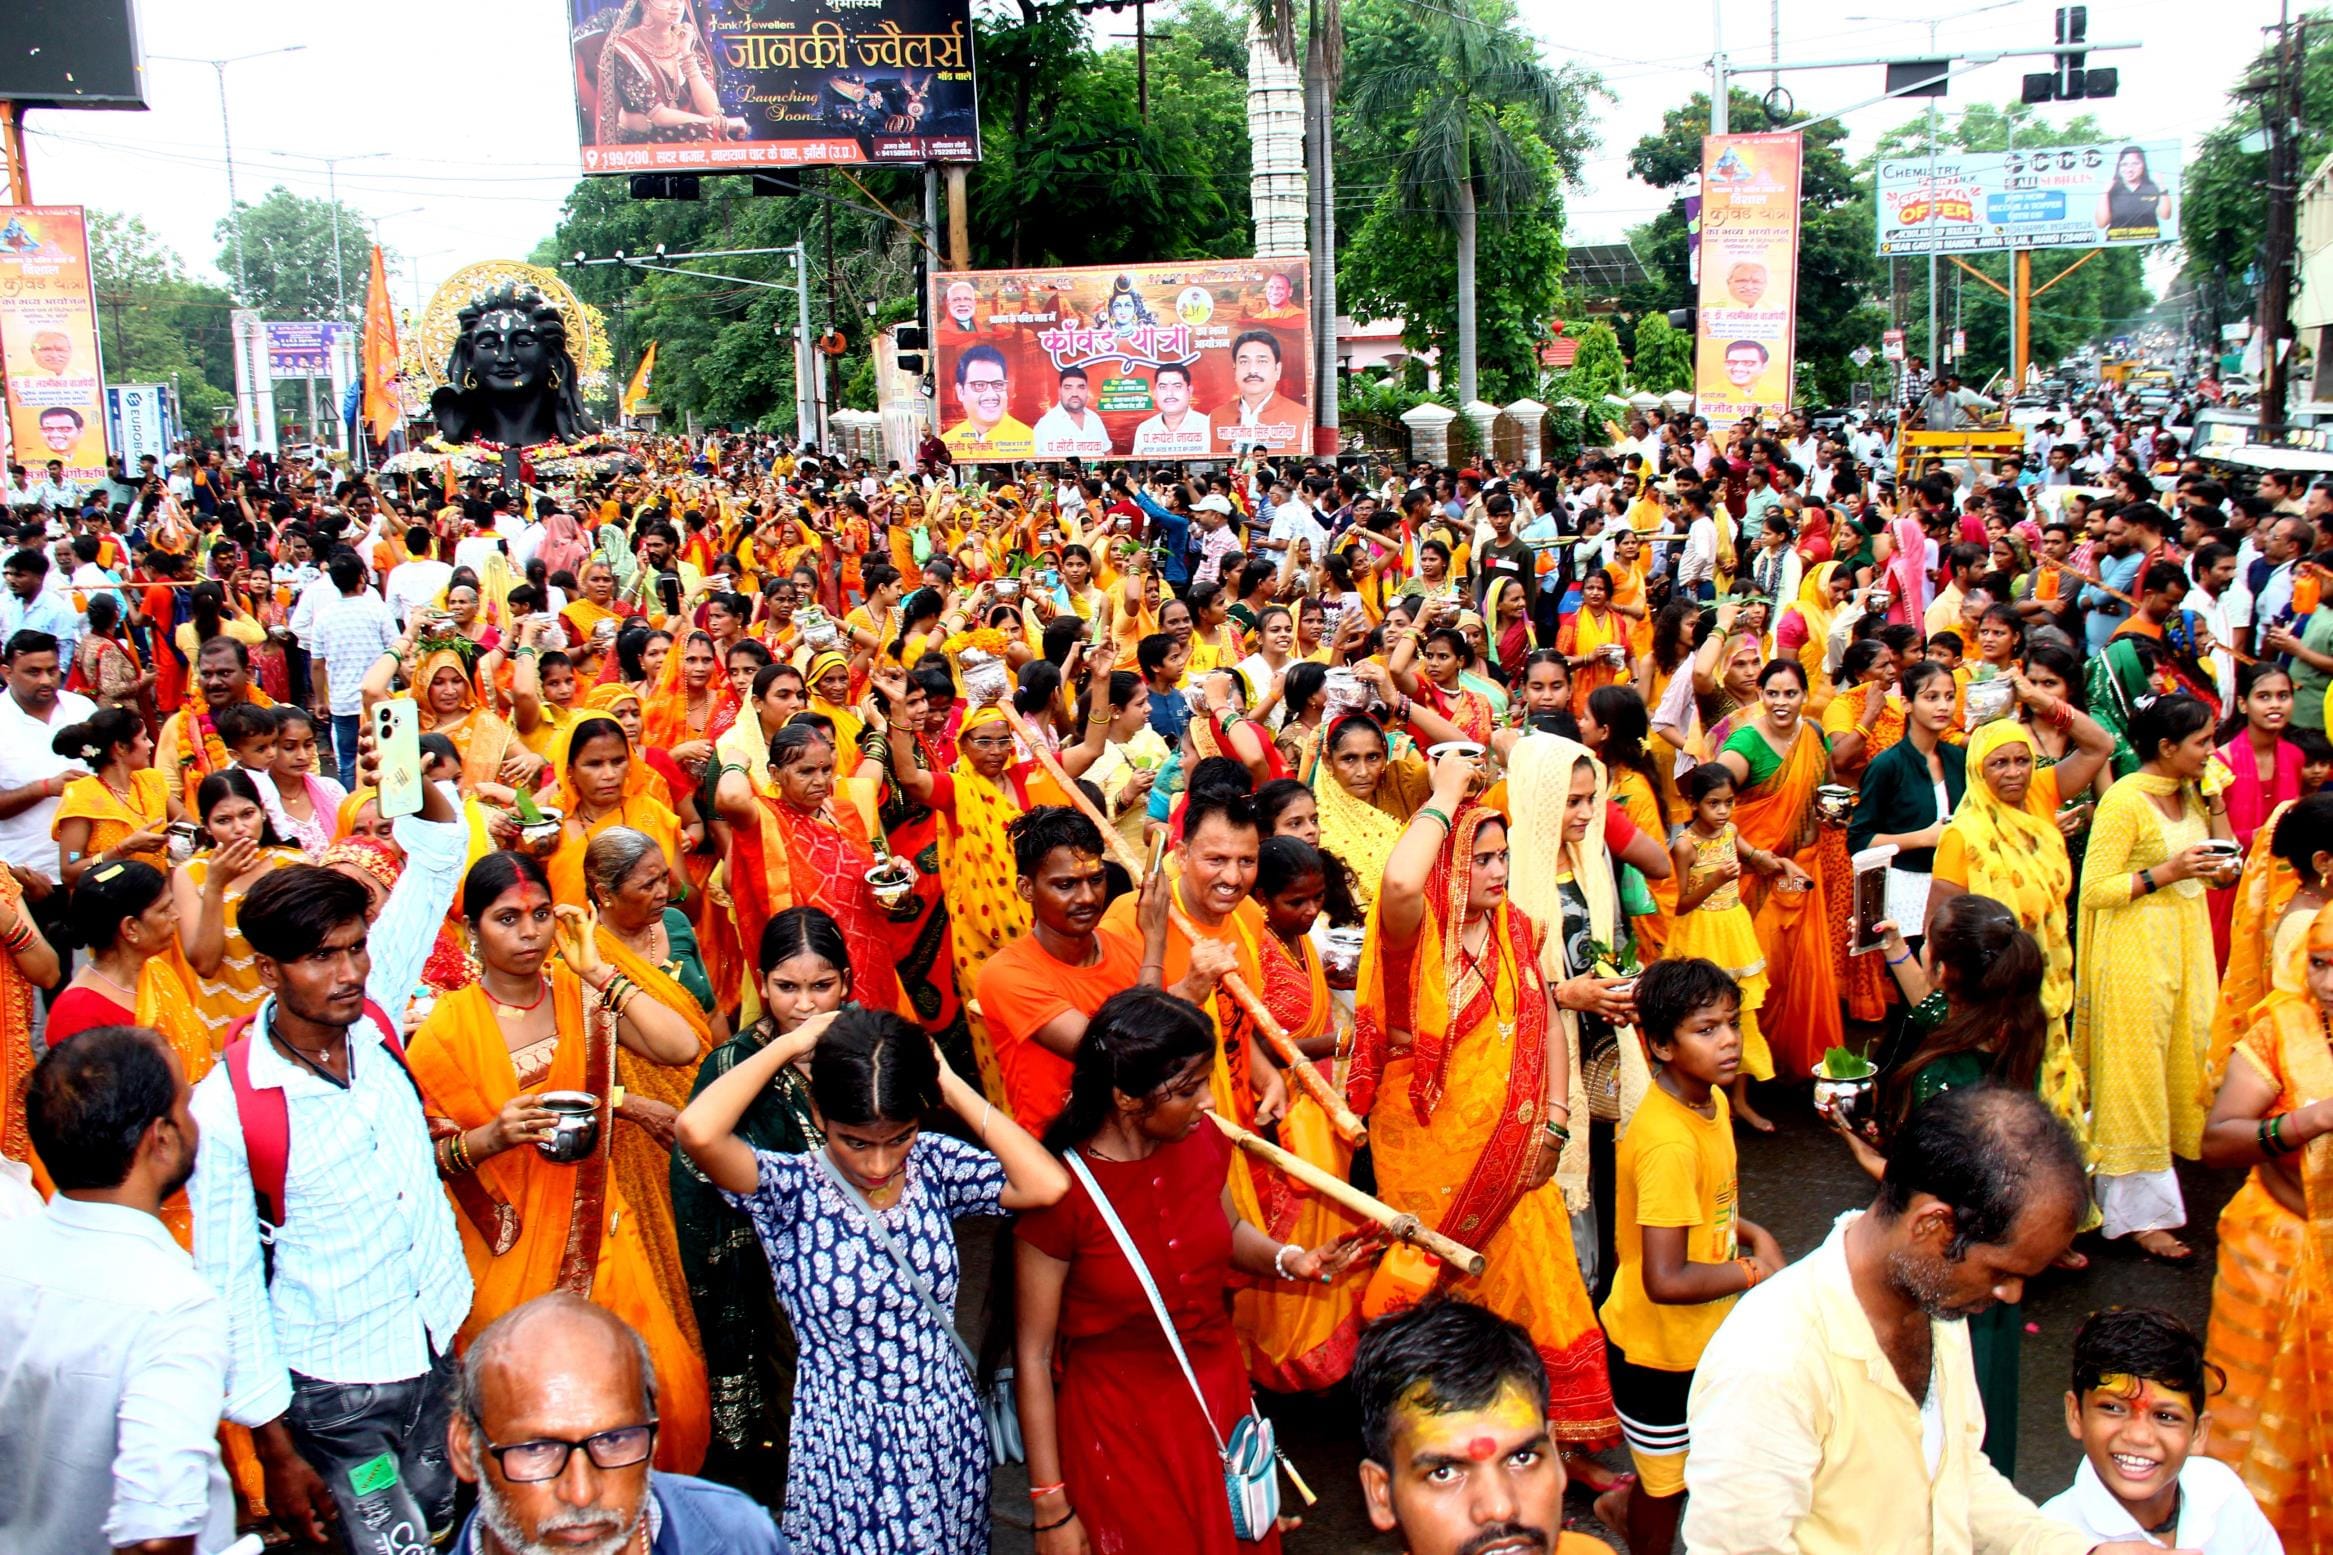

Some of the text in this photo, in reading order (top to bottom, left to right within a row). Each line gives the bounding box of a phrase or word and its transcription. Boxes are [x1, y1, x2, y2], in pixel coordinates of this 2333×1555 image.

[722, 21, 849, 69] जानकी
[736, 84, 818, 106] Launching
[768, 144, 777, 160] के
[1129, 323, 1191, 360] यात्रा
[1076, 441, 1102, 452] नायक
[1176, 431, 1203, 443] नायक
